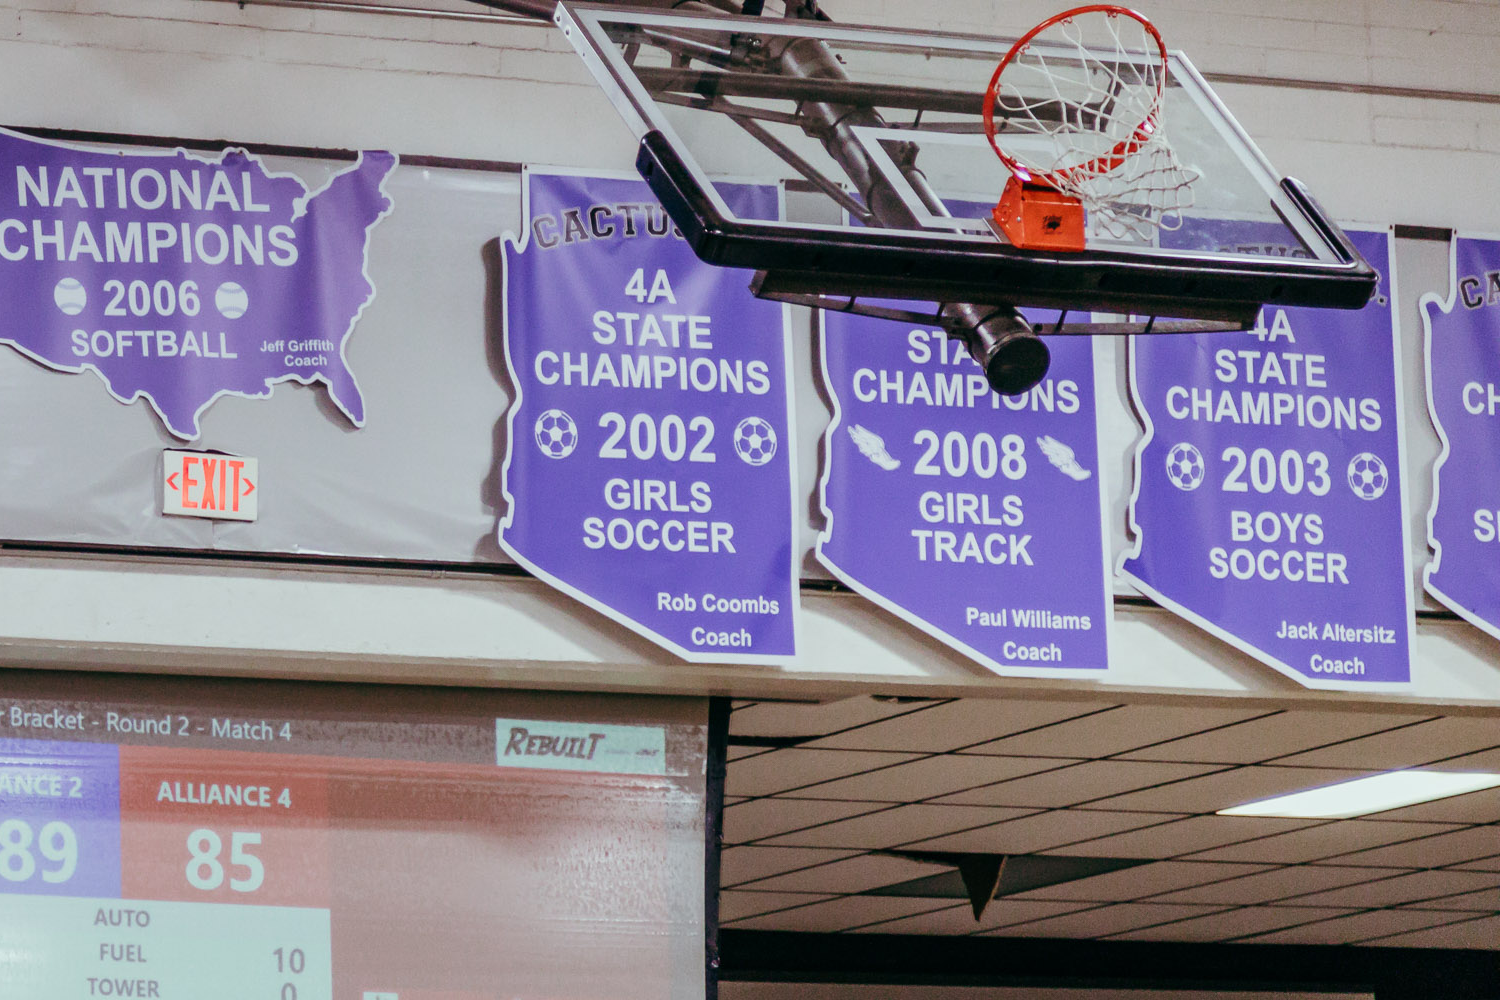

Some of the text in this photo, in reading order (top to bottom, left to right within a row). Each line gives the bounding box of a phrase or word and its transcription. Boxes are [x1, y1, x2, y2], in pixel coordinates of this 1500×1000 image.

[15, 165, 271, 213] NATIONAL
[531, 203, 686, 250] CACTU
[103, 279, 201, 317] 2006
[624, 269, 677, 304] 4A
[592, 311, 714, 350] STATE
[1247, 309, 1296, 344] 4A
[71, 330, 238, 359] SOFTBALL
[260, 338, 334, 353] Jeff Griffith
[284, 355, 328, 366] Coach
[534, 350, 771, 395] CHAMPIONS
[1215, 350, 1327, 388] STATE
[1165, 386, 1383, 432] CHAMPIONS
[599, 412, 717, 463] 2002
[913, 430, 1027, 480] 2008
[181, 456, 245, 512] EXIT
[1221, 447, 1332, 496] 2003
[603, 478, 712, 513] GIRLS
[918, 491, 1024, 528] GIRLS
[582, 518, 736, 554] SOCCER
[1230, 510, 1324, 545] BOYS
[911, 529, 1034, 566] TRACK
[1208, 548, 1349, 584] SOCCER
[657, 593, 780, 615] Rob Coombs
[965, 607, 1092, 631] Paul Williams
[691, 627, 752, 647] Coach
[1276, 621, 1396, 644] Jack Altersitz
[1003, 640, 1062, 661] Coach
[1310, 654, 1365, 675] Coach
[10, 707, 85, 730] Bracket
[106, 712, 173, 736] Round
[178, 717, 190, 736] 2
[212, 719, 273, 740] Match
[279, 722, 292, 741] 4
[68, 776, 83, 798] 2
[157, 781, 292, 808] ALLIANCE 4
[185, 829, 265, 892] 85
[93, 909, 150, 927] AUTO
[99, 944, 146, 963] FUEL
[273, 948, 305, 974] 10
[87, 978, 159, 998] TOWER
